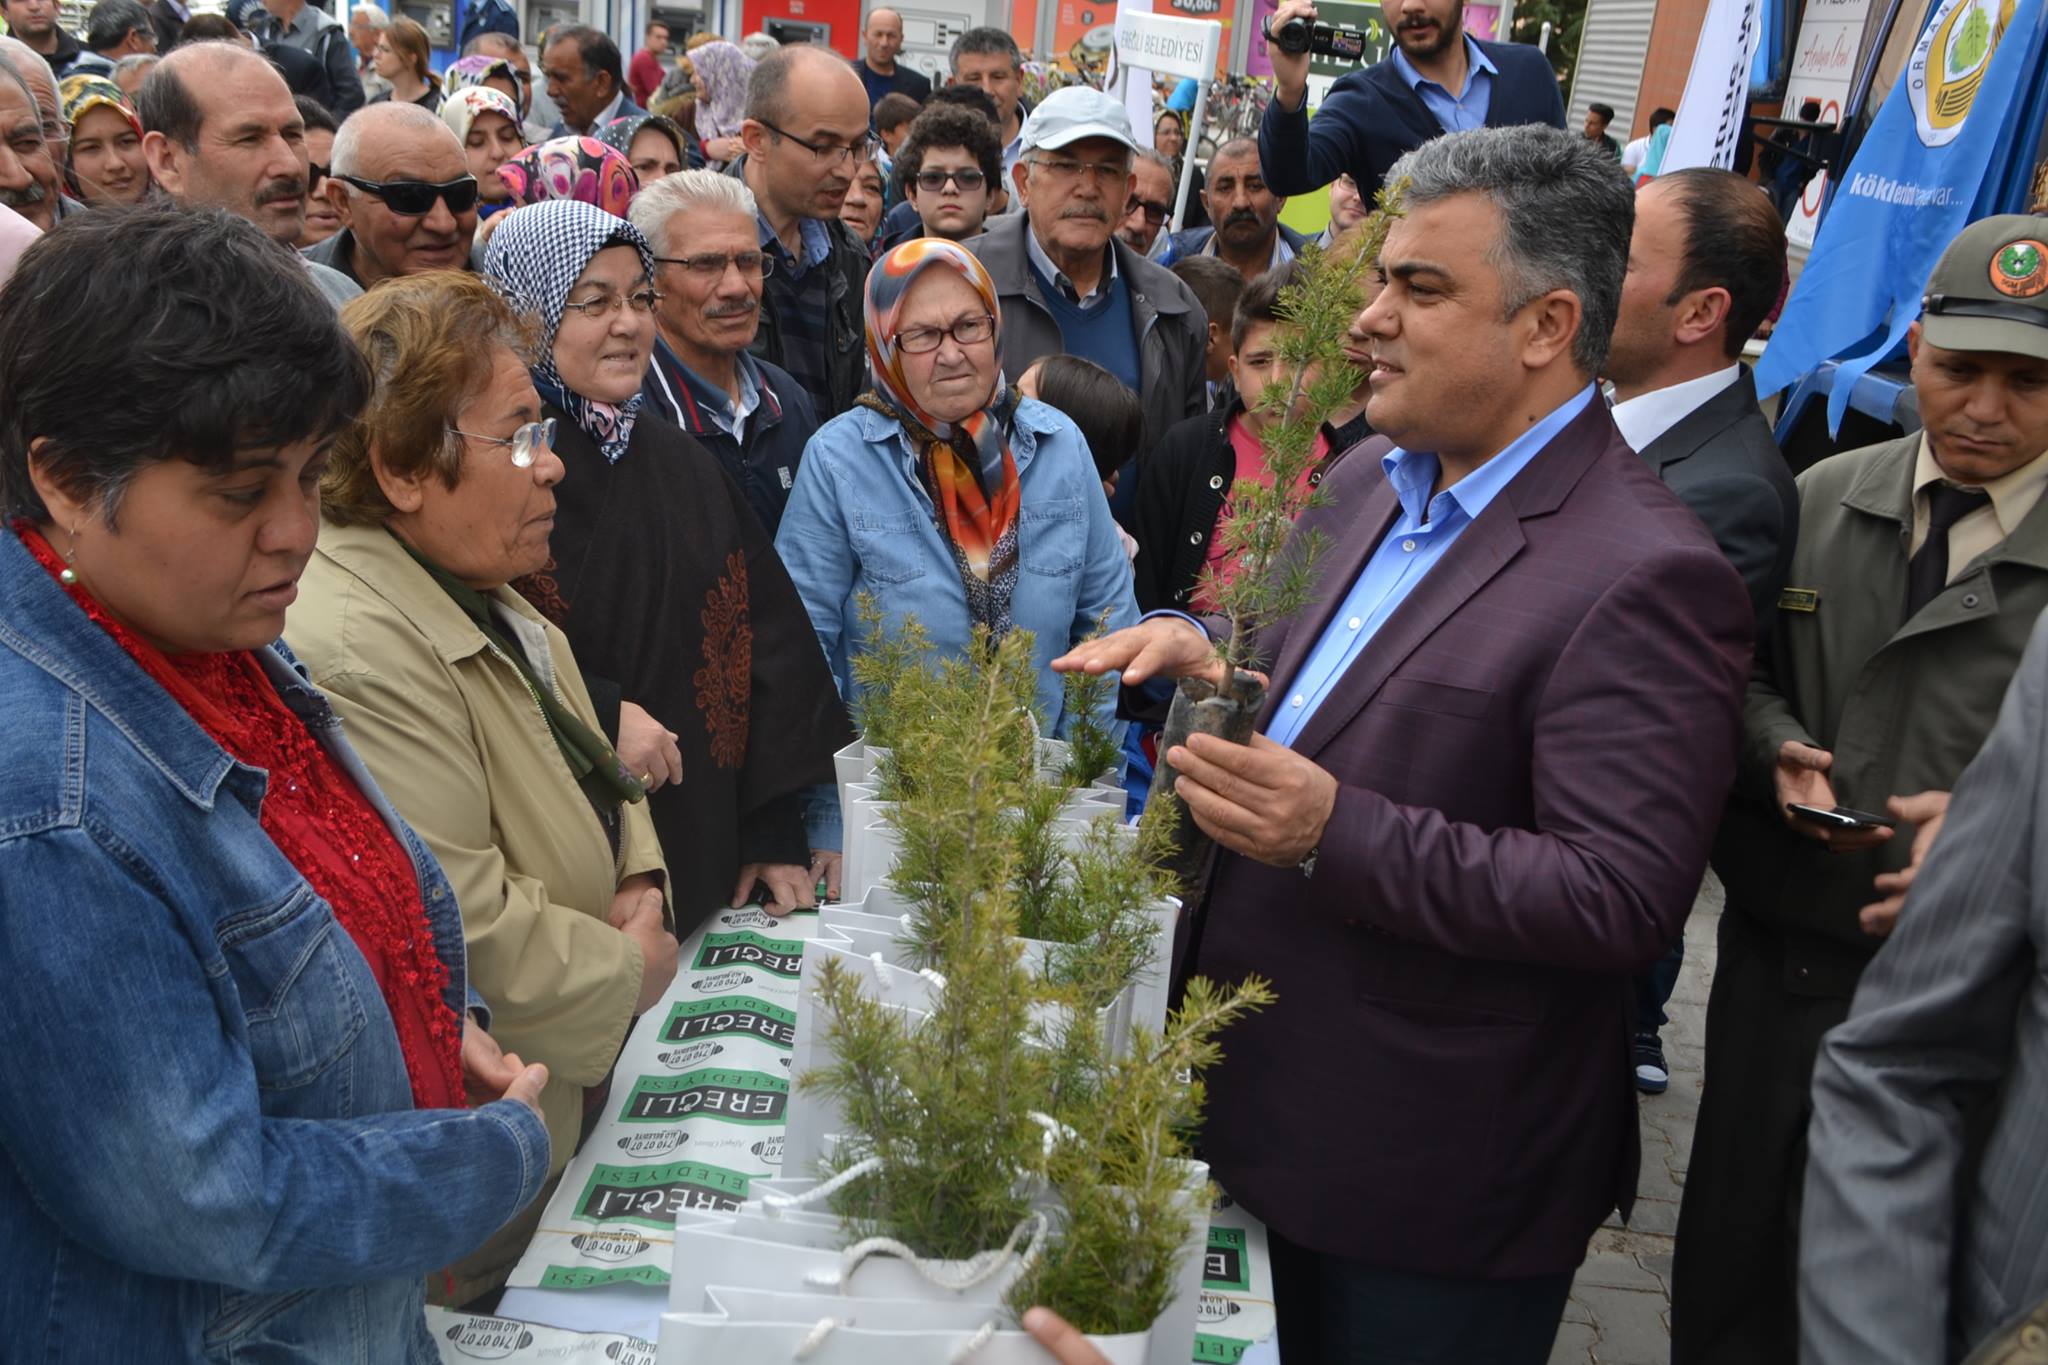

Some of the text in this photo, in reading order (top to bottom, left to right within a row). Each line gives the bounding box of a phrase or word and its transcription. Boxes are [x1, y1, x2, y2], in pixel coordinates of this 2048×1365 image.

[1120, 29, 1205, 63] EREĞLİ BELEDİYESİ
[1912, 4, 1950, 90] ORMAN
[708, 934, 796, 951] EDİYESİ
[710, 946, 802, 972] REĞLİ
[679, 999, 785, 1018] LEDİYESİ
[670, 1050, 708, 1064] 710 07 07
[641, 1089, 775, 1116] EREĞLİ
[631, 1139, 674, 1151] 710 07 07
[601, 1166, 744, 1190] ELEDİYESİ
[586, 1240, 632, 1255] 710 07 07
[460, 1333, 513, 1349] 710 07 07
[627, 1335, 657, 1353] ELEDİYE
